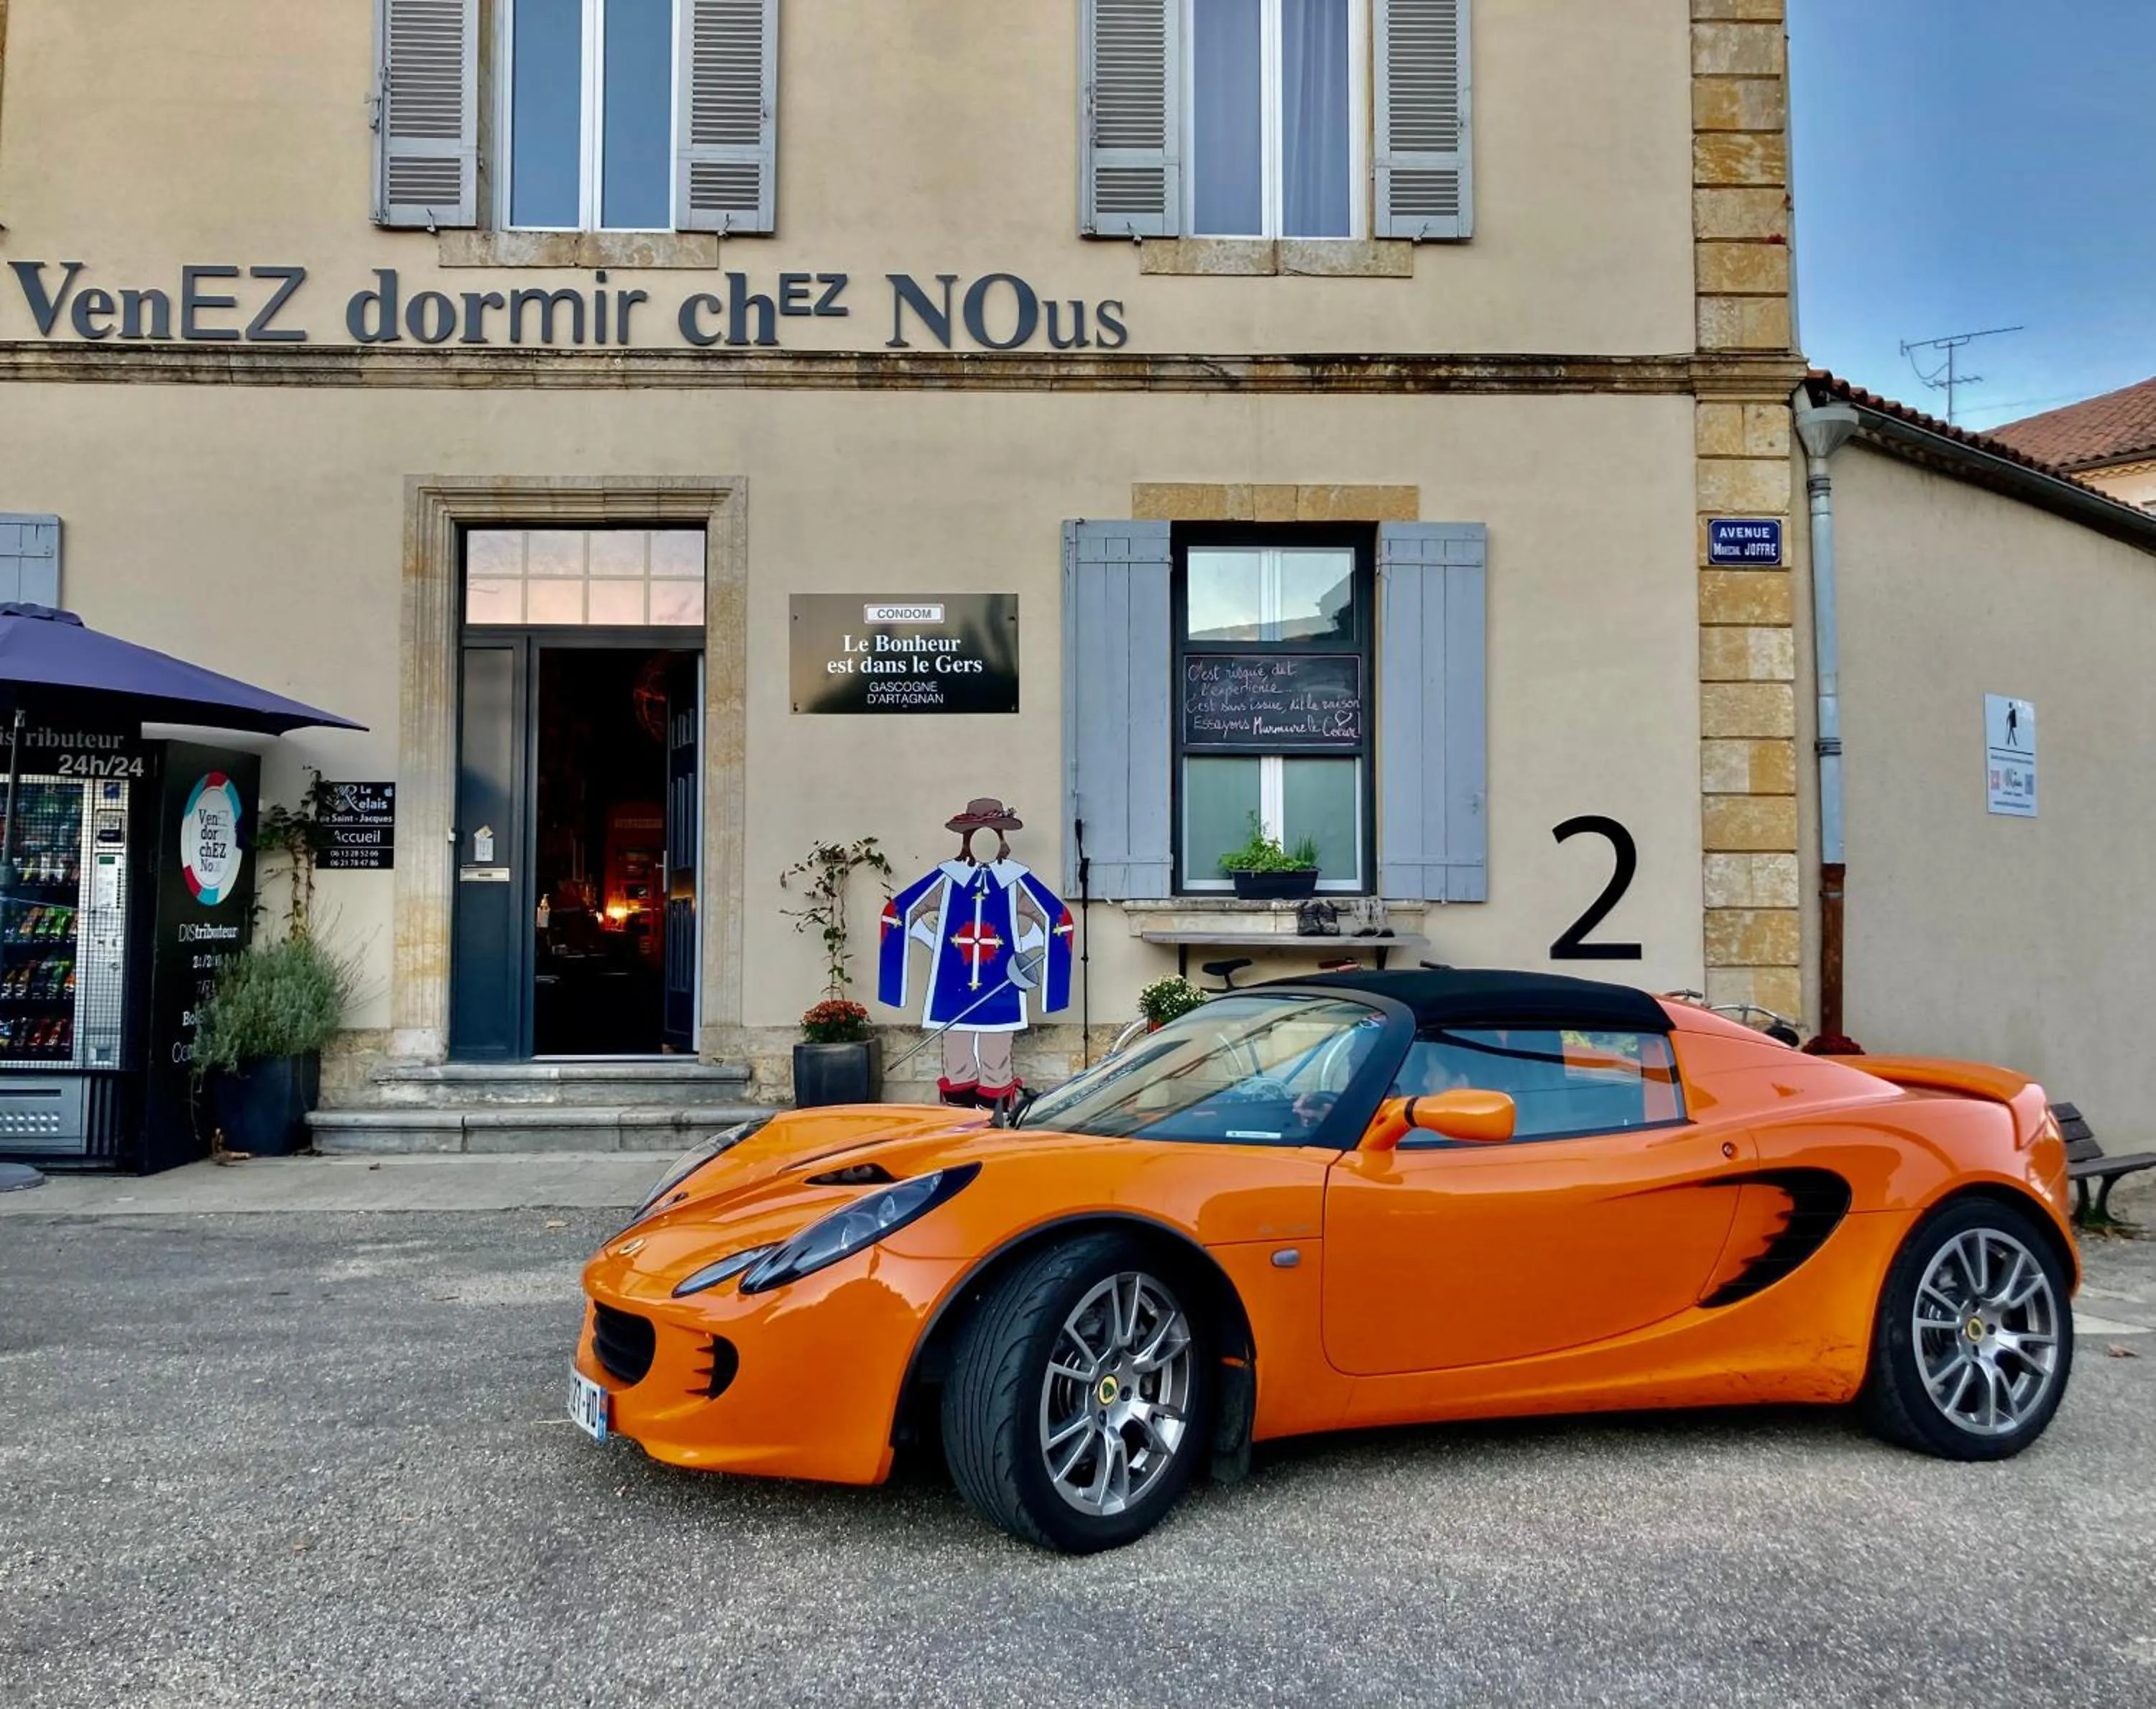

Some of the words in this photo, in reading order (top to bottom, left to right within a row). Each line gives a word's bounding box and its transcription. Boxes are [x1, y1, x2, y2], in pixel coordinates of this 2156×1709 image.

[6, 261, 307, 341] VenEZ
[346, 268, 648, 344] dormir
[678, 272, 849, 346] chEZ
[885, 272, 1128, 349] NOus
[1719, 527, 1771, 538] AVENUE
[1744, 543, 1777, 556] JOFFRE
[877, 609, 932, 619] CONDOM
[843, 635, 869, 652] Le
[875, 635, 961, 652] Bonheur
[827, 657, 854, 673] est
[860, 656, 907, 673] dans
[912, 655, 929, 673] le
[935, 655, 983, 673] Gers
[868, 681, 938, 693] GASCOGNE
[867, 693, 944, 704] D'ARTAGNAN
[57, 754, 144, 777] 24h/24
[360, 784, 372, 794] Le
[331, 813, 354, 823] Saint
[359, 813, 393, 824] Jacques
[334, 829, 381, 843] Accueil
[1549, 815, 1642, 960] 2
